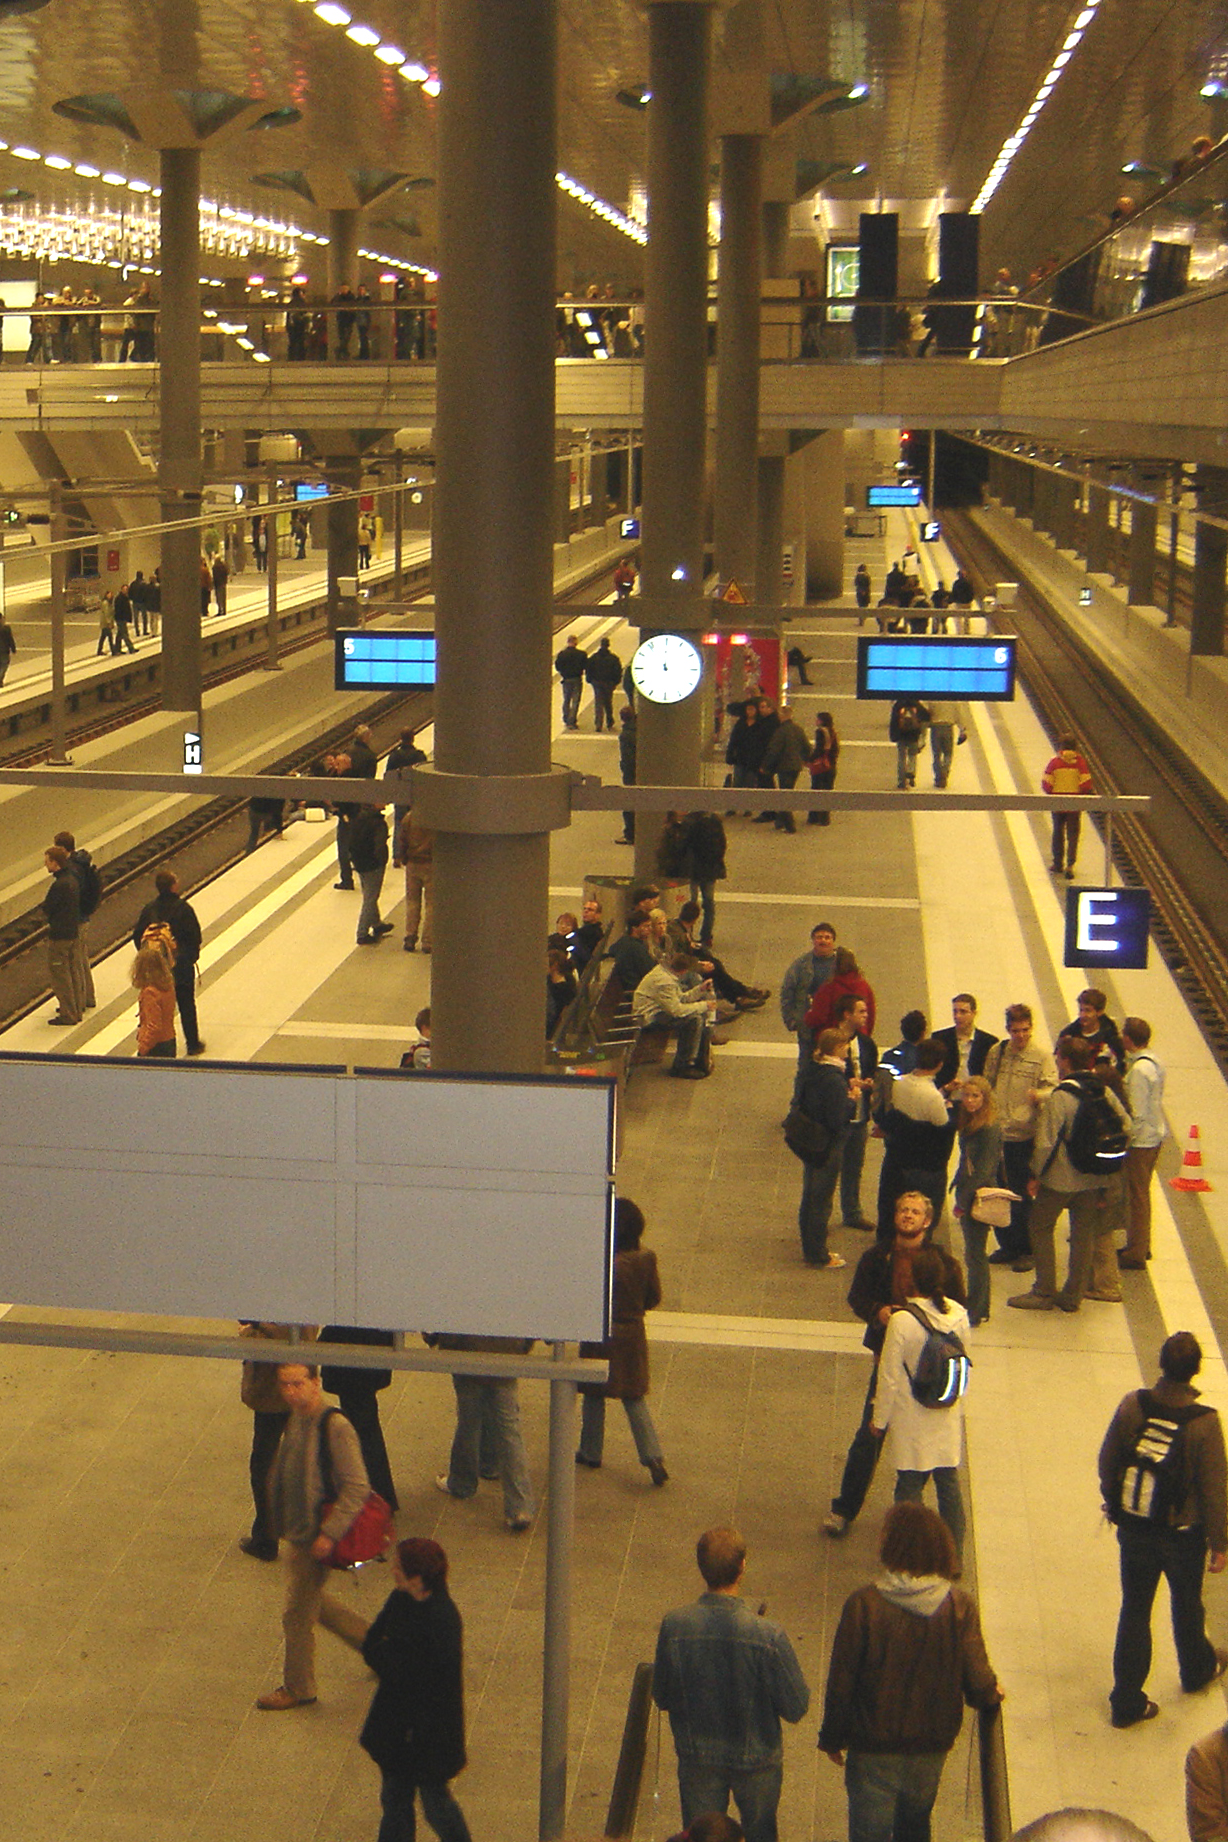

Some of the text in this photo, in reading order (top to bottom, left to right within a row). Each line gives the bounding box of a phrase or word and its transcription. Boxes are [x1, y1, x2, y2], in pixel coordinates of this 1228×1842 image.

[622, 520, 634, 537] F
[925, 522, 939, 539] F
[343, 638, 355, 655] 5
[994, 647, 1008, 664] 6
[185, 744, 200, 764] H
[1076, 891, 1119, 951] E
